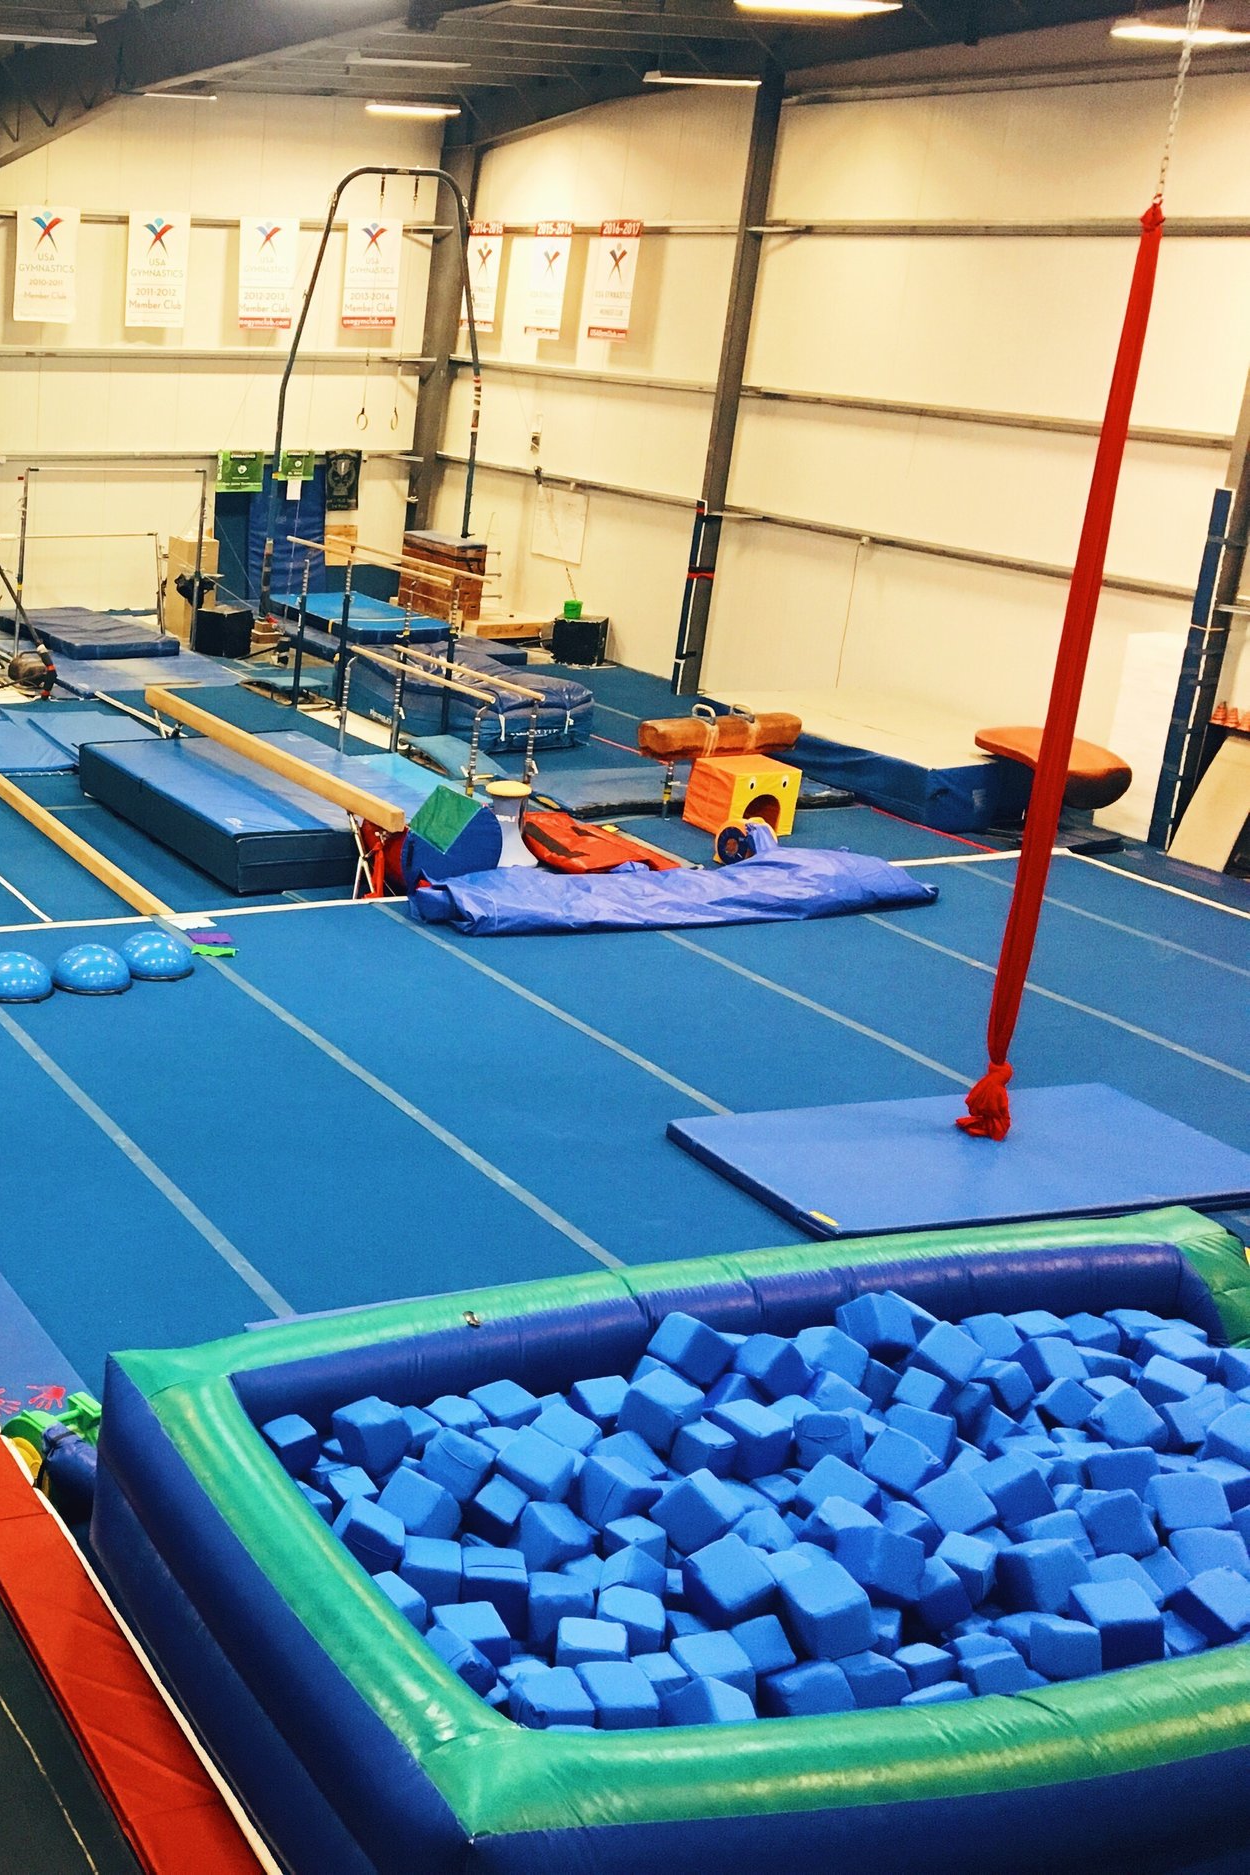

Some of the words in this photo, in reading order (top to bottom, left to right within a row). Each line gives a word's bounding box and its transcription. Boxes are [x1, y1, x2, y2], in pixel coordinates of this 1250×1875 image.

[537, 223, 572, 235] 2015-2016
[603, 222, 640, 234] 2016-2017
[37, 253, 55, 261] USA
[148, 257, 167, 266] USA
[19, 263, 76, 274] GYMNASTICS
[131, 268, 184, 278] GYMNASTICS
[136, 287, 177, 297] 2011-2012
[244, 291, 286, 301] 2012-2013
[350, 292, 390, 301] 2013-2014
[129, 299, 161, 309] Member
[163, 299, 182, 310] Club
[239, 303, 270, 313] Member
[271, 303, 290, 313] Club
[344, 303, 373, 313] Member
[376, 303, 395, 313] Club
